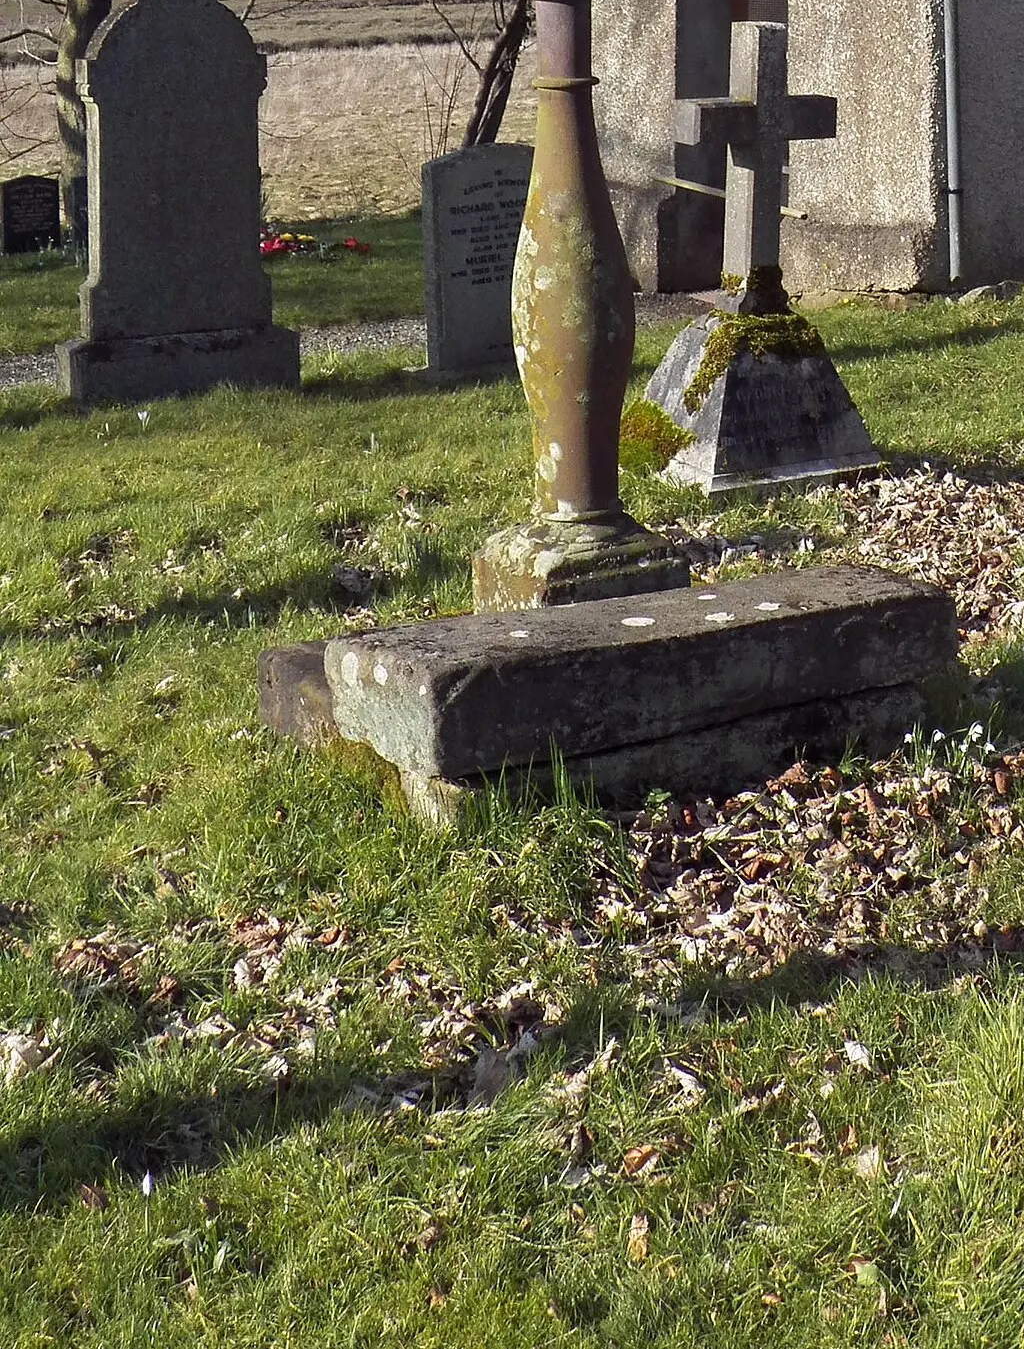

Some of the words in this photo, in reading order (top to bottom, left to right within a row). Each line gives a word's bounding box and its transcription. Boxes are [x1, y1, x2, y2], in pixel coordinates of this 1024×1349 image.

[464, 181, 494, 195] LOVING
[450, 202, 494, 214] RICHARD
[470, 225, 490, 233] DIED
[465, 253, 503, 265] MURIEL
[472, 267, 490, 275] DIED
[472, 276, 492, 285] AGED
